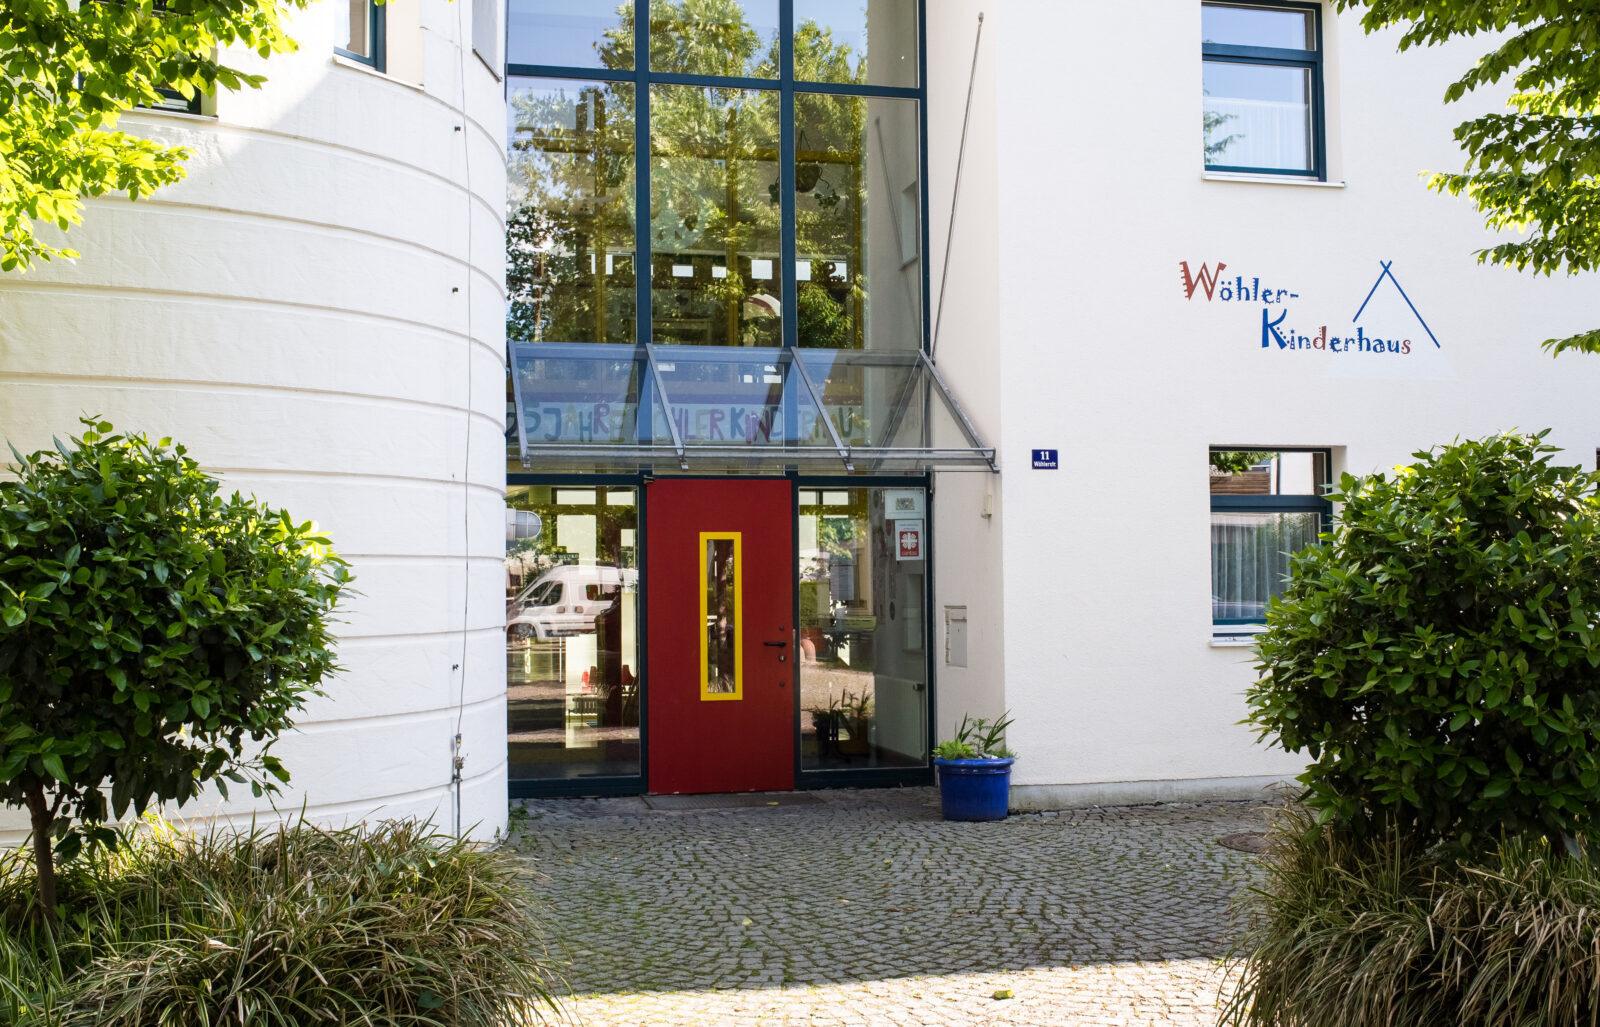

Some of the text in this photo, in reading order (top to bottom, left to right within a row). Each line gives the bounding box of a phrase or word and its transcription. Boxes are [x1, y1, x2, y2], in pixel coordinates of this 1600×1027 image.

[1179, 260, 1299, 304] Wöhler-
[1261, 308, 1411, 355] Kinderhaus
[543, 403, 626, 442] JAHRE
[1040, 451, 1050, 460] 11
